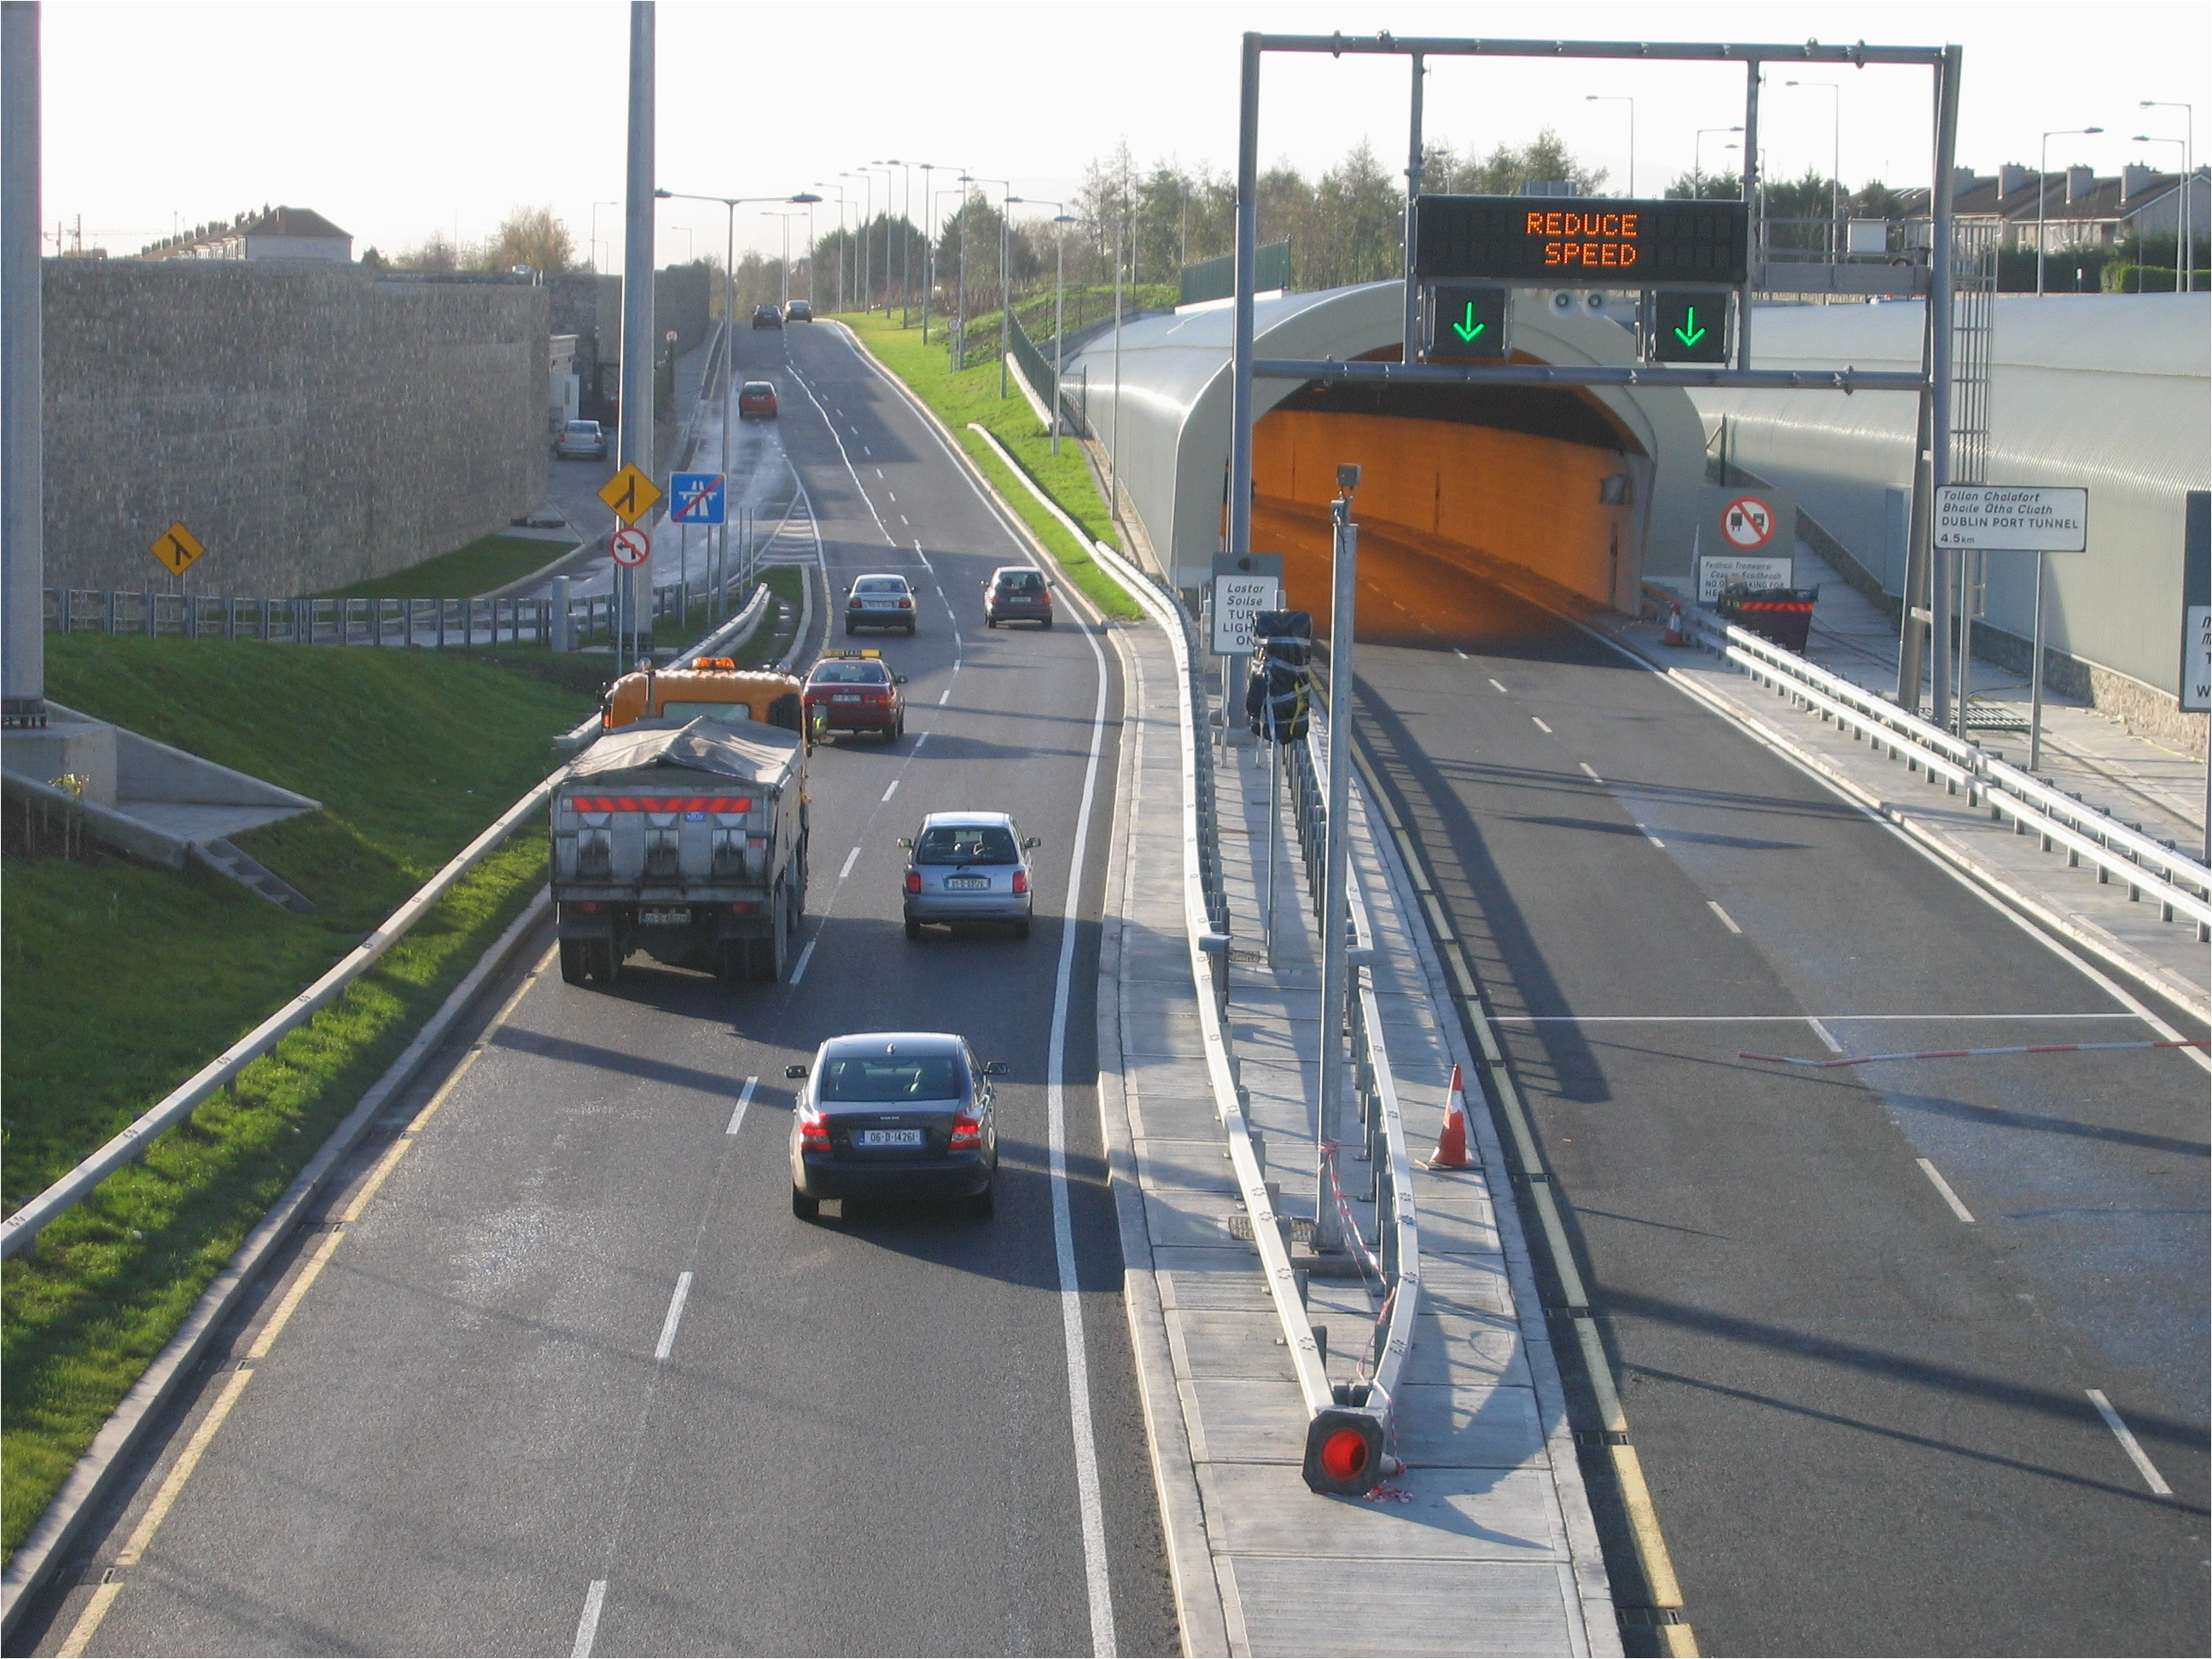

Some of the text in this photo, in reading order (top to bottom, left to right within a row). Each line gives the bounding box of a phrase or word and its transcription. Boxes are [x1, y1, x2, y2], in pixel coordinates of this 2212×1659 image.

[1527, 212, 1639, 236] REDUCE
[1545, 242, 1637, 265] SPEED
[1941, 516, 2079, 529] DUBLIN PORT TUNNEL
[1227, 583, 1265, 593] Lastar
[1227, 596, 1263, 606] Soilse
[1229, 609, 1253, 620] TUR
[1223, 623, 1253, 632] LIGH
